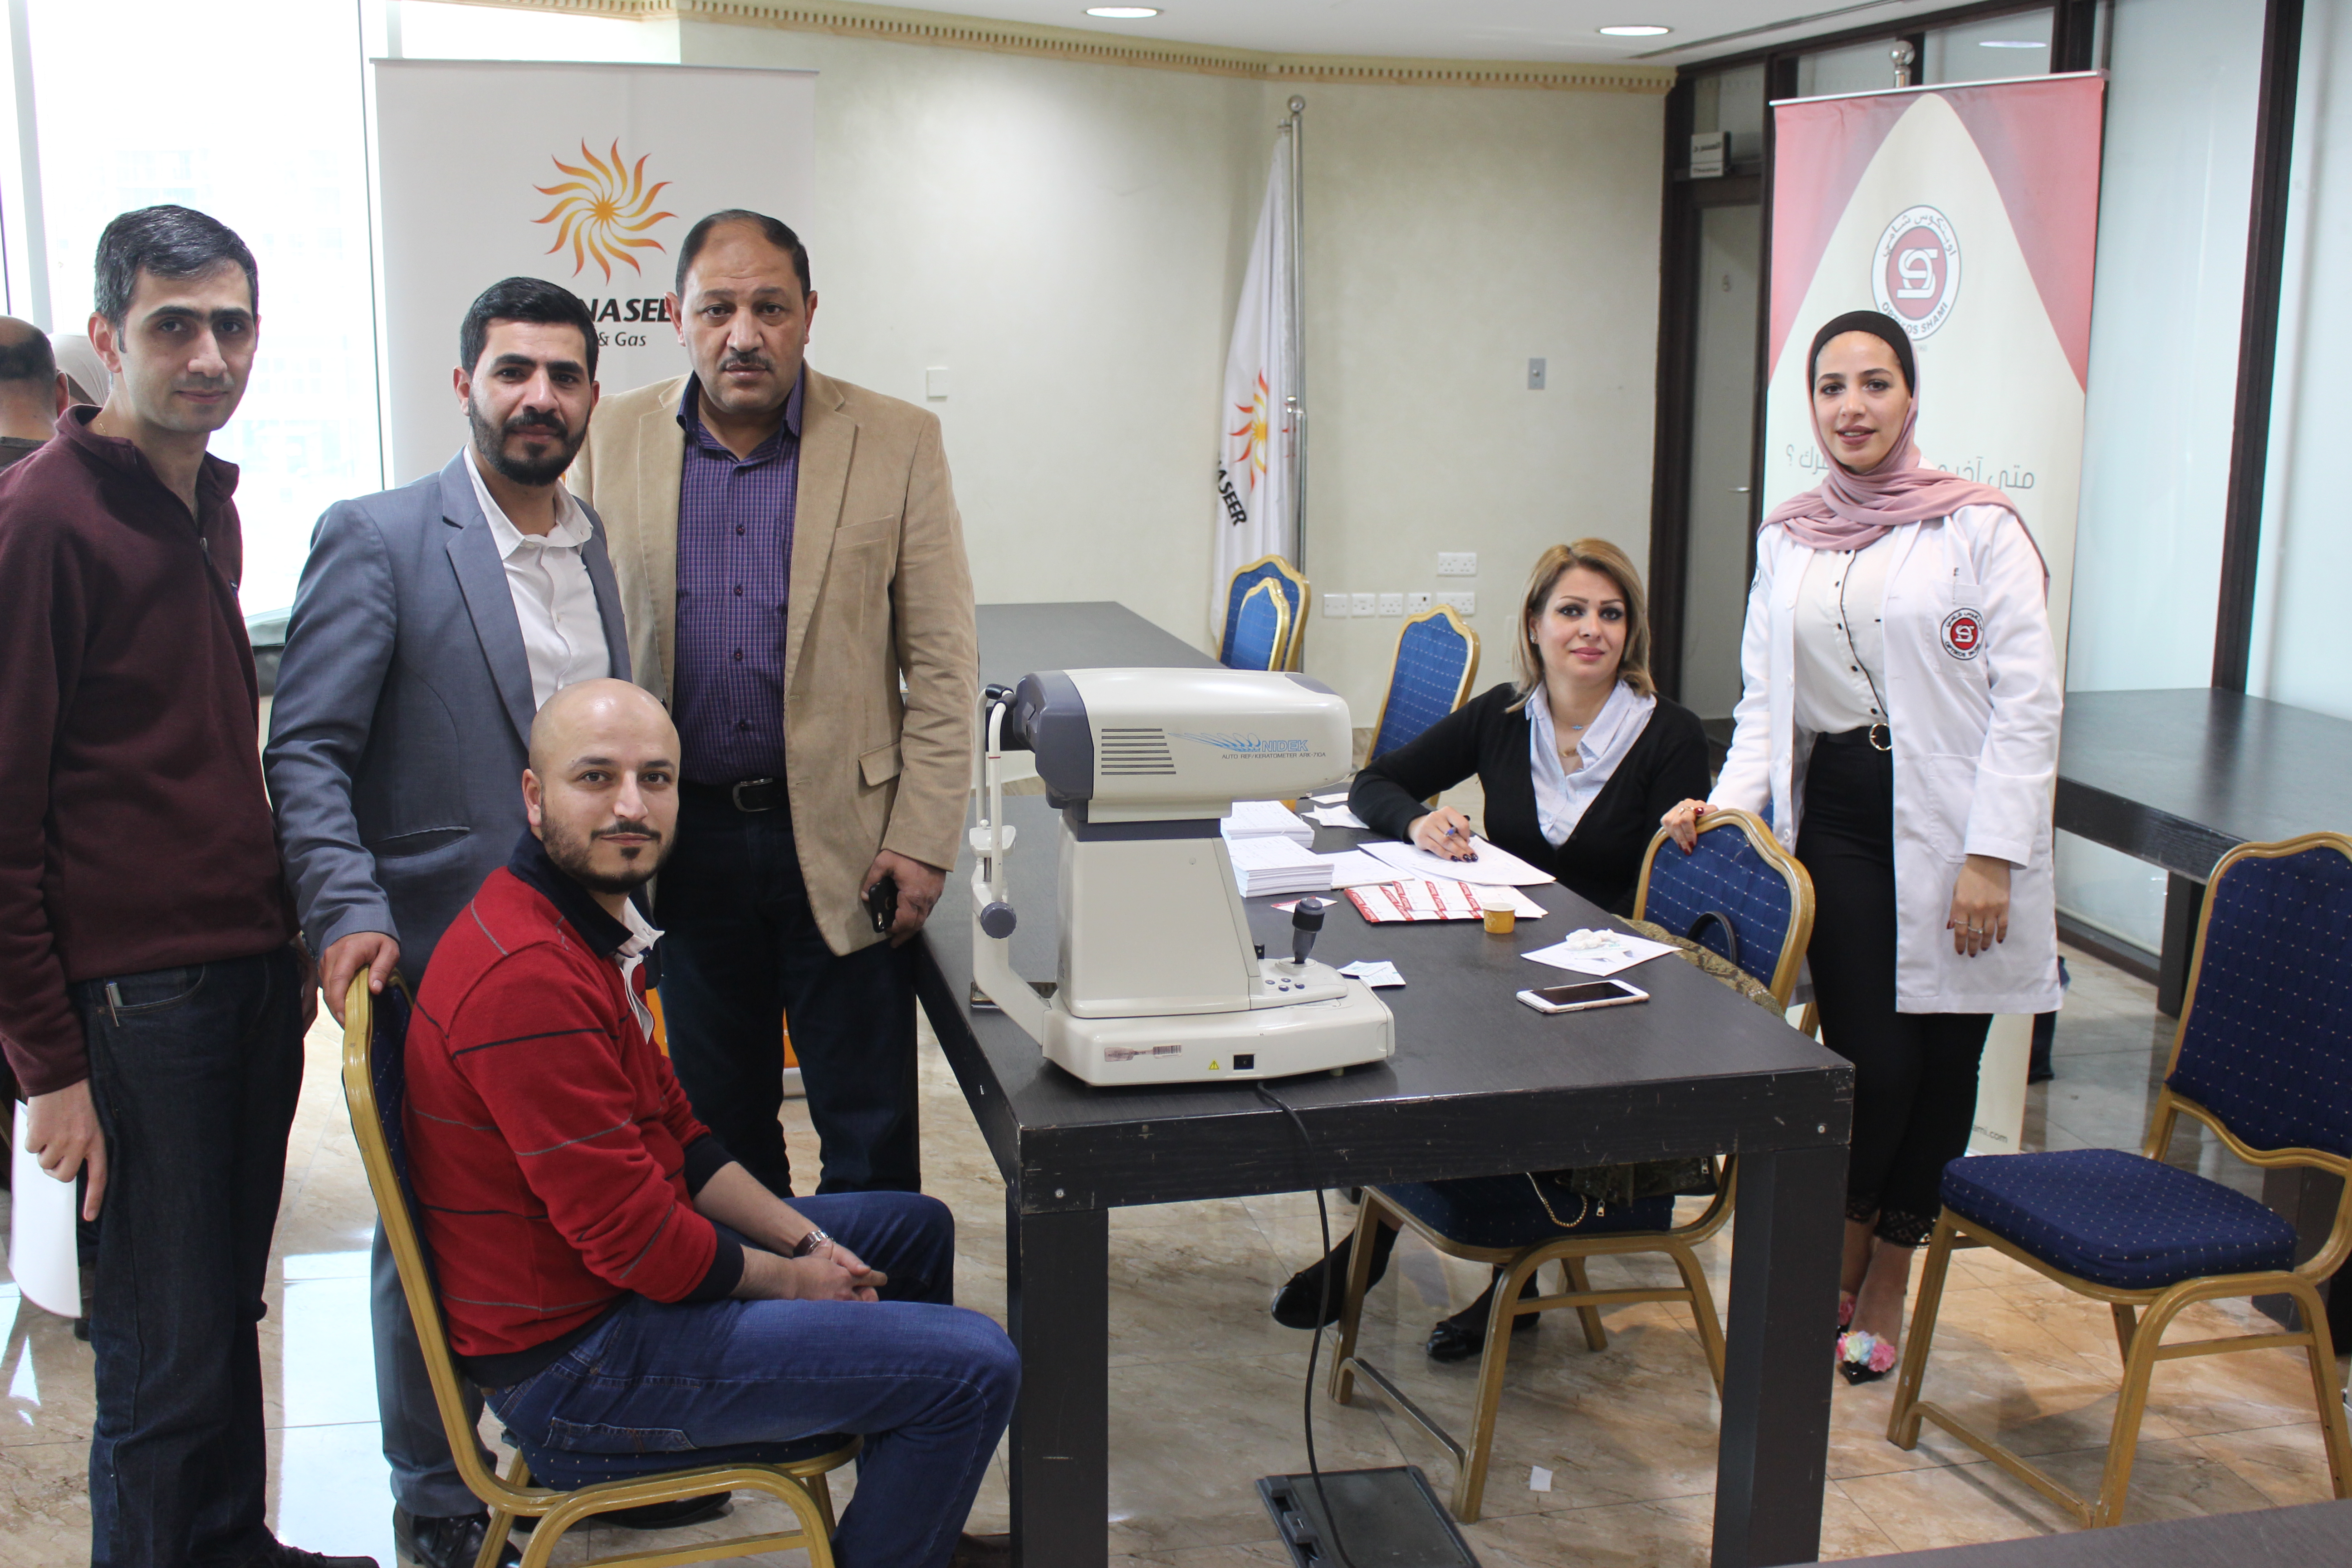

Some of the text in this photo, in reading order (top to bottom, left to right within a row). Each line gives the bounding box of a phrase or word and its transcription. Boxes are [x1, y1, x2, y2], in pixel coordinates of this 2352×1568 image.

[1921, 302, 1948, 333] SHAMI
[615, 332, 647, 346] Gas
[1262, 740, 1308, 752] NIDEK
